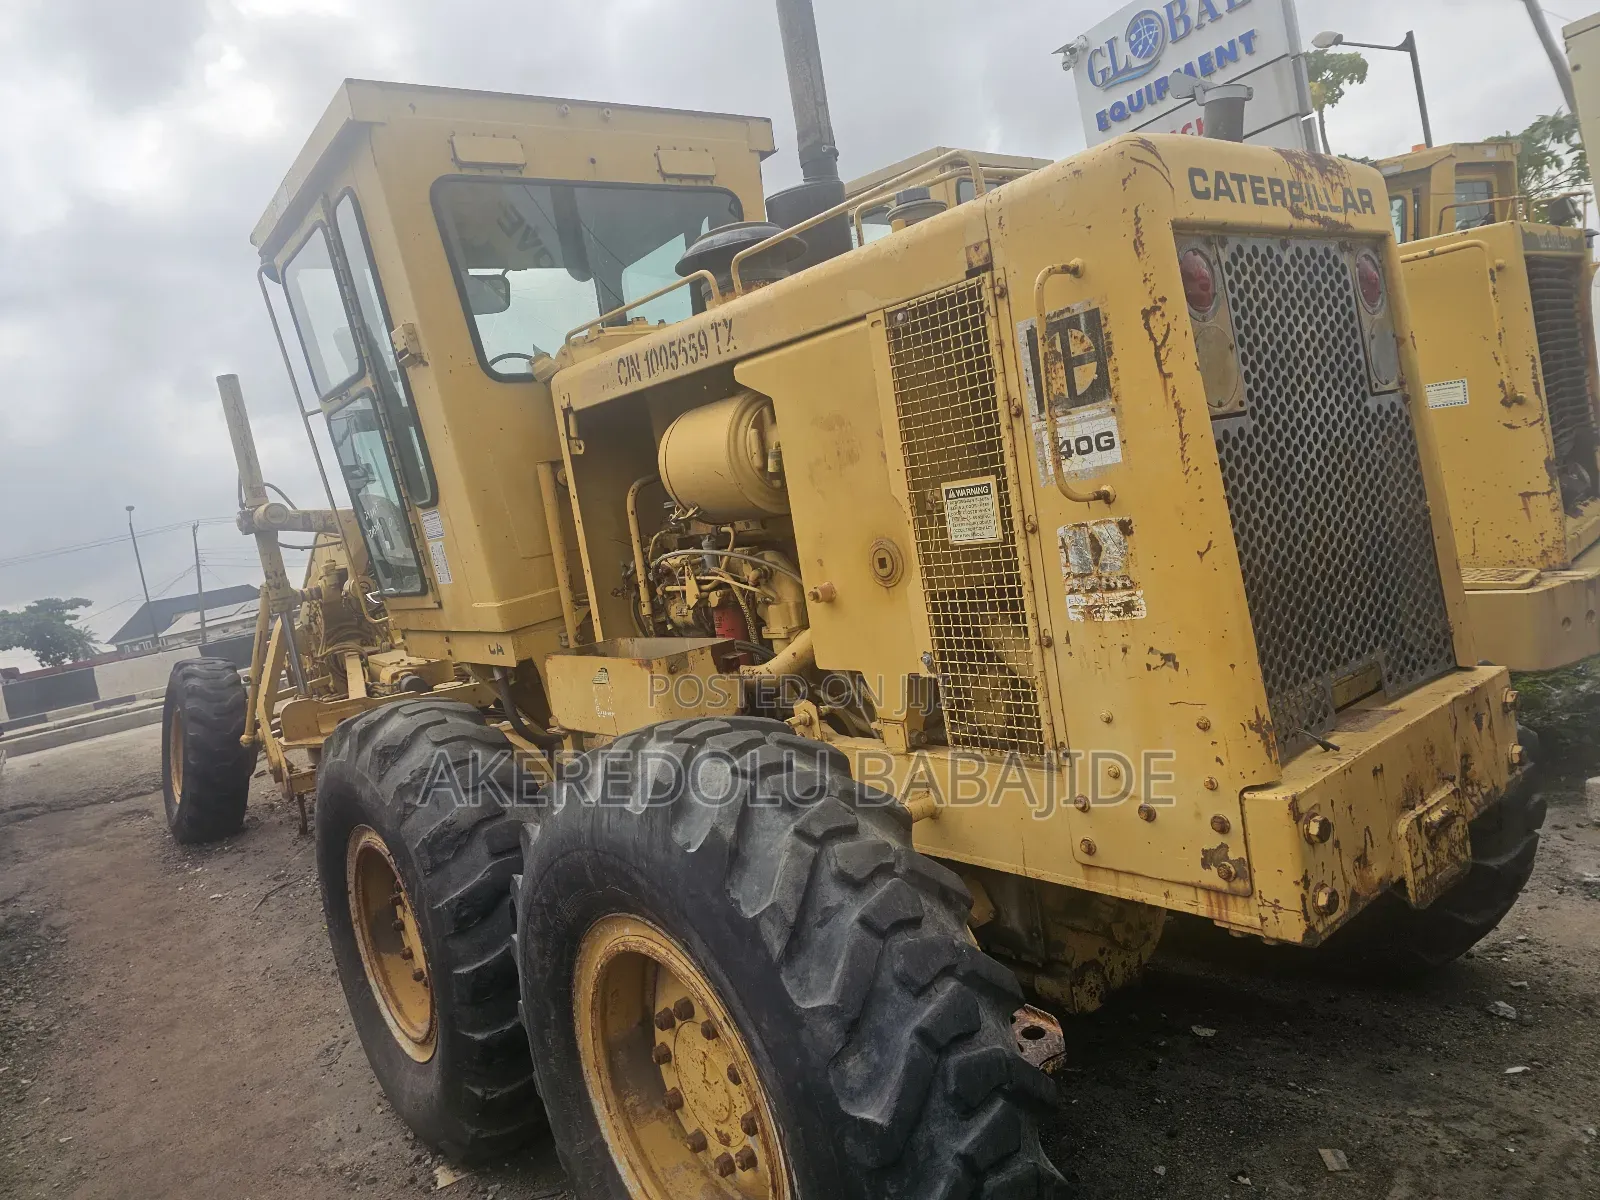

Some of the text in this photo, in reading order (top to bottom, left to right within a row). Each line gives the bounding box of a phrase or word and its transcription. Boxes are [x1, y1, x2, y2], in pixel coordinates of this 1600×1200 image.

[1188, 167, 1375, 214] CATERPILLAR
[617, 352, 642, 387] CIN
[955, 485, 989, 497] WARNING
